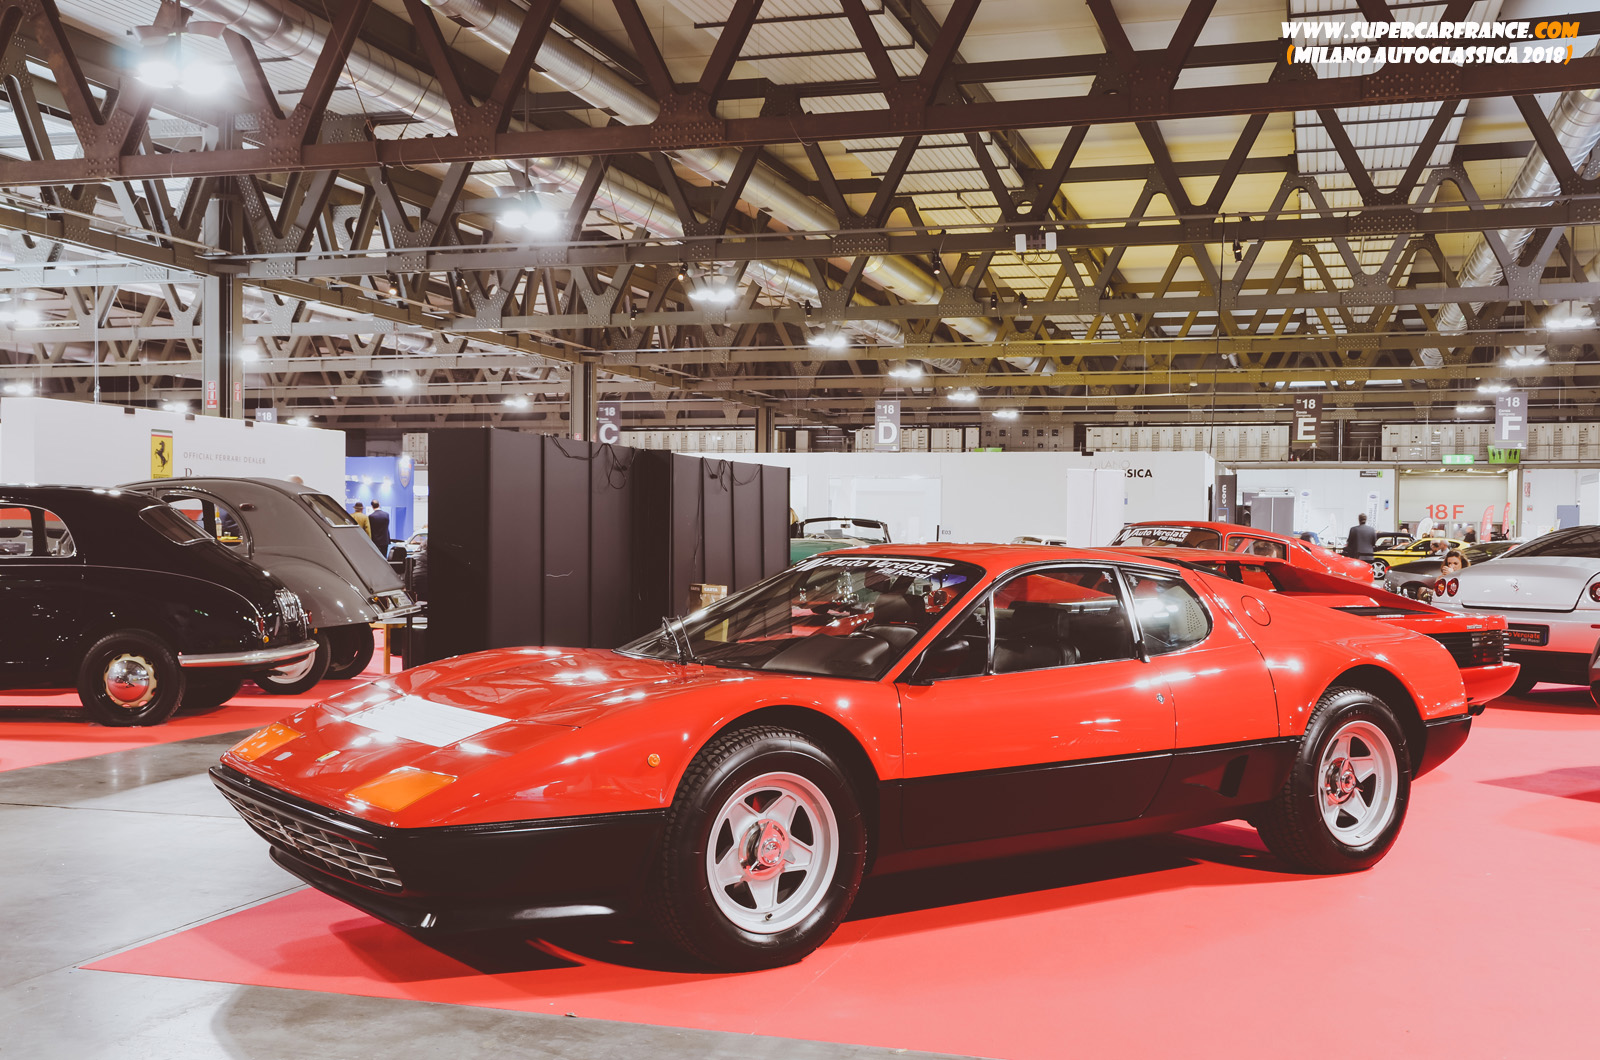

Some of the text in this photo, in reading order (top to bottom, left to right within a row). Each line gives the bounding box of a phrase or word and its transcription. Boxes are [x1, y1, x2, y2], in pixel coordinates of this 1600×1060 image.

[1302, 398, 1316, 409] 18
[1505, 396, 1520, 408] 18
[604, 407, 616, 416] 18
[882, 404, 894, 414] 18
[262, 412, 272, 420] 18
[599, 423, 618, 444] C
[878, 422, 898, 444] D
[1297, 418, 1316, 440] E
[1502, 416, 1522, 440] F
[183, 451, 266, 464] OFFICIAL FERRARI DEALER
[1124, 469, 1152, 478] SICA
[1426, 504, 1464, 520] 18 F
[826, 558, 869, 567] Auto
